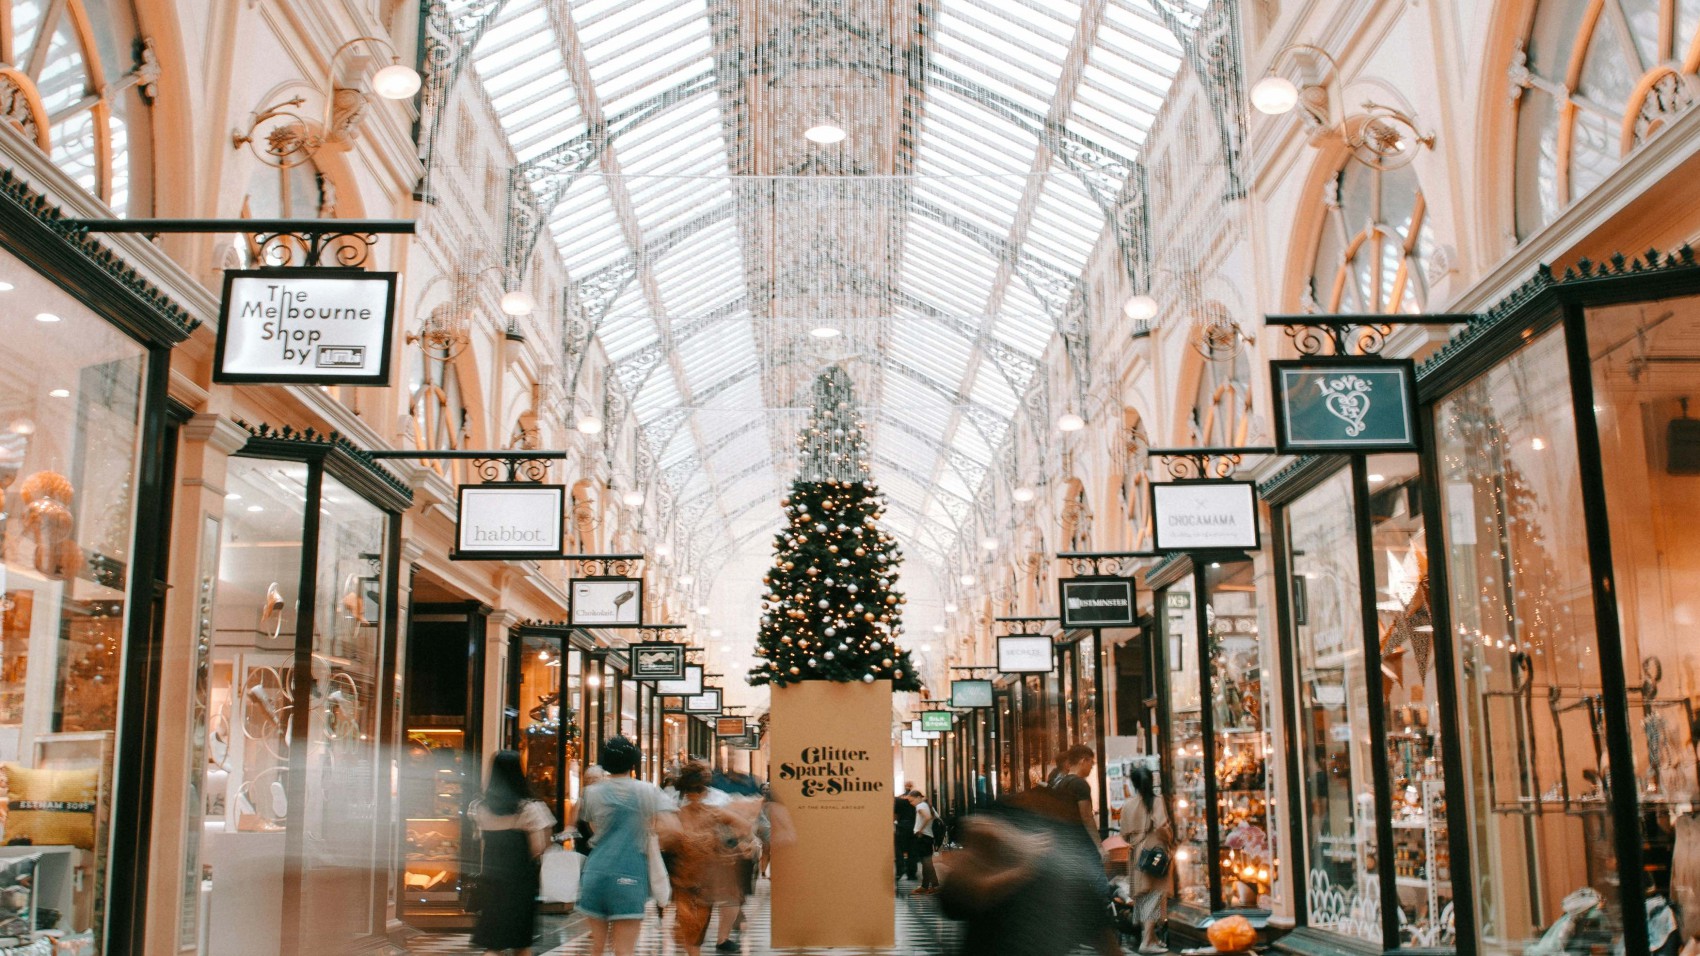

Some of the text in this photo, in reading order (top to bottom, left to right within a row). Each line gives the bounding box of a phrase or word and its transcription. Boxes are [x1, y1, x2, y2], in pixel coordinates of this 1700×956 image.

[267, 285, 307, 302] The
[241, 301, 371, 320] Melbourne
[261, 322, 321, 345] Shop
[282, 347, 311, 365] by
[1168, 514, 1236, 526] CHOCAMAMA
[474, 525, 546, 542] habbot.
[801, 746, 869, 764] Glitter.
[779, 762, 854, 780] Sparkle
